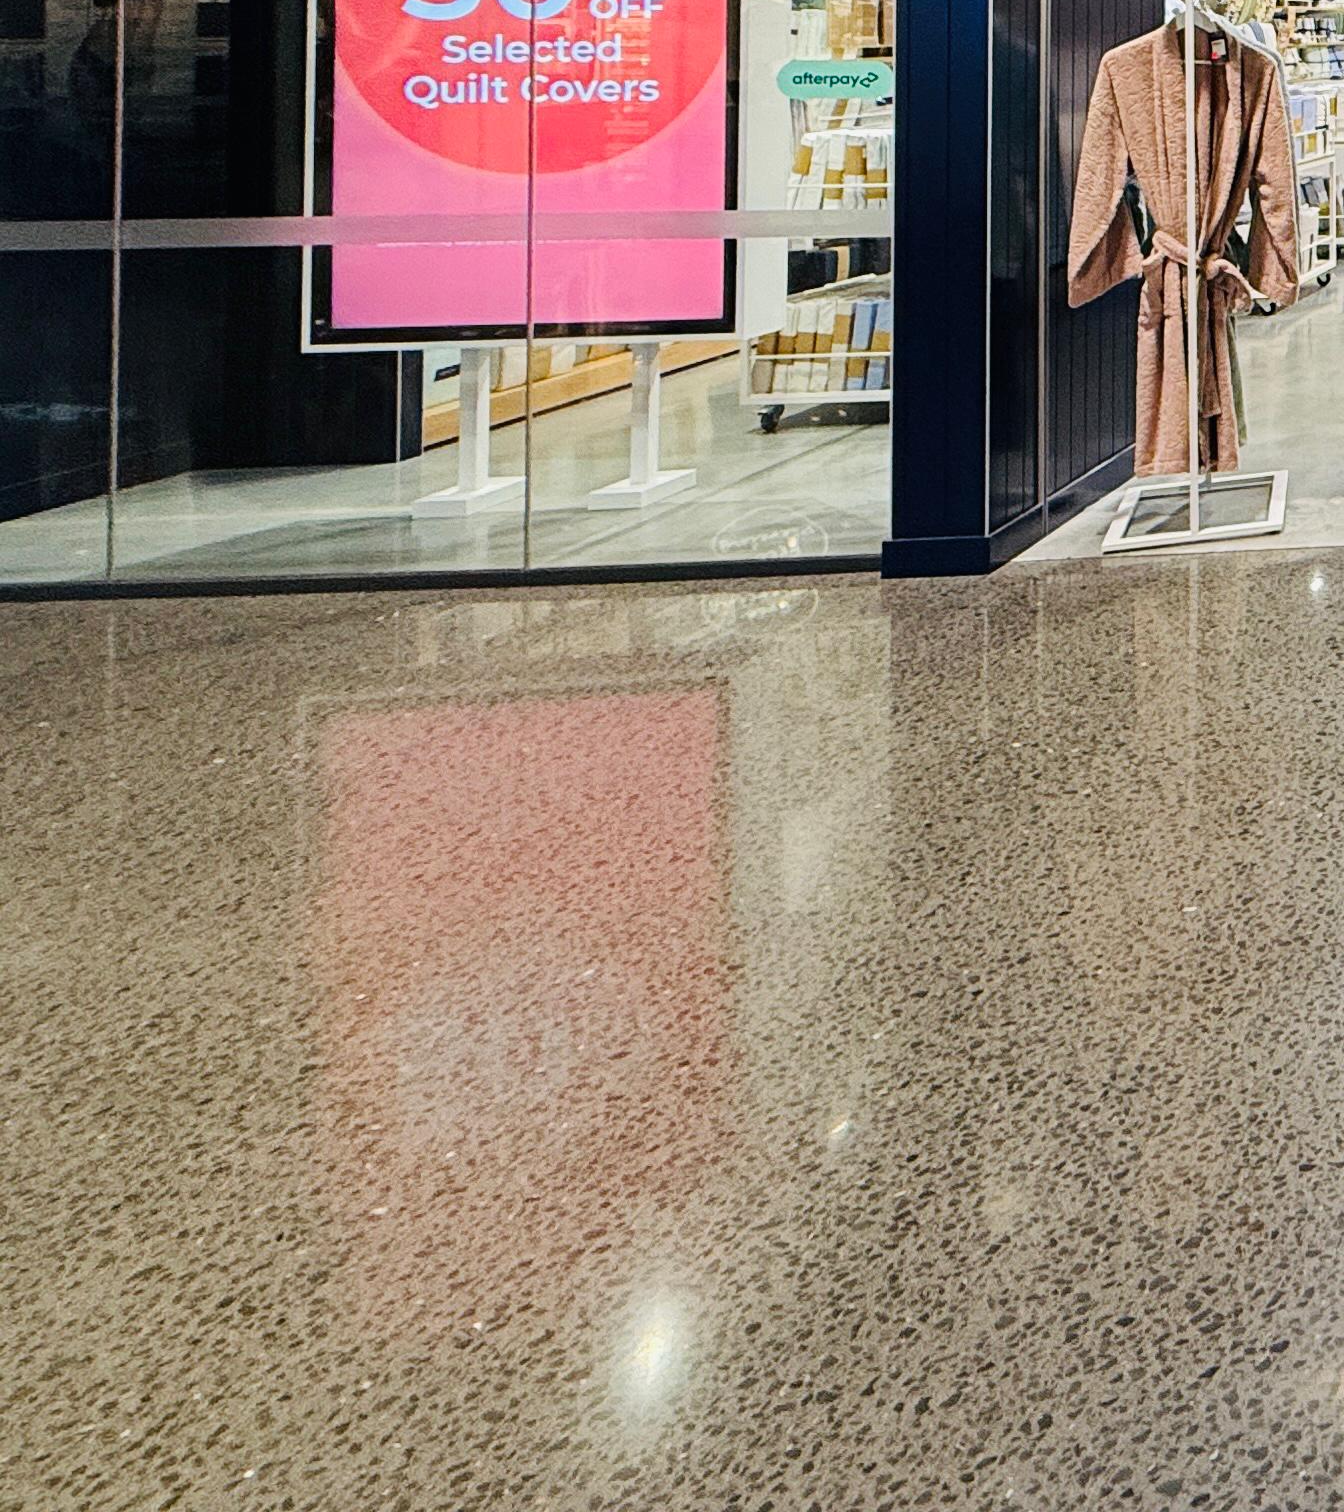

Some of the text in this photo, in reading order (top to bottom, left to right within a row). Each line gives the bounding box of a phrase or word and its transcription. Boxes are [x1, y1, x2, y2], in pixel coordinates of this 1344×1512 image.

[442, 34, 622, 63] Selected
[404, 73, 660, 109] Quilt Covers
[792, 72, 861, 88] afterpay
